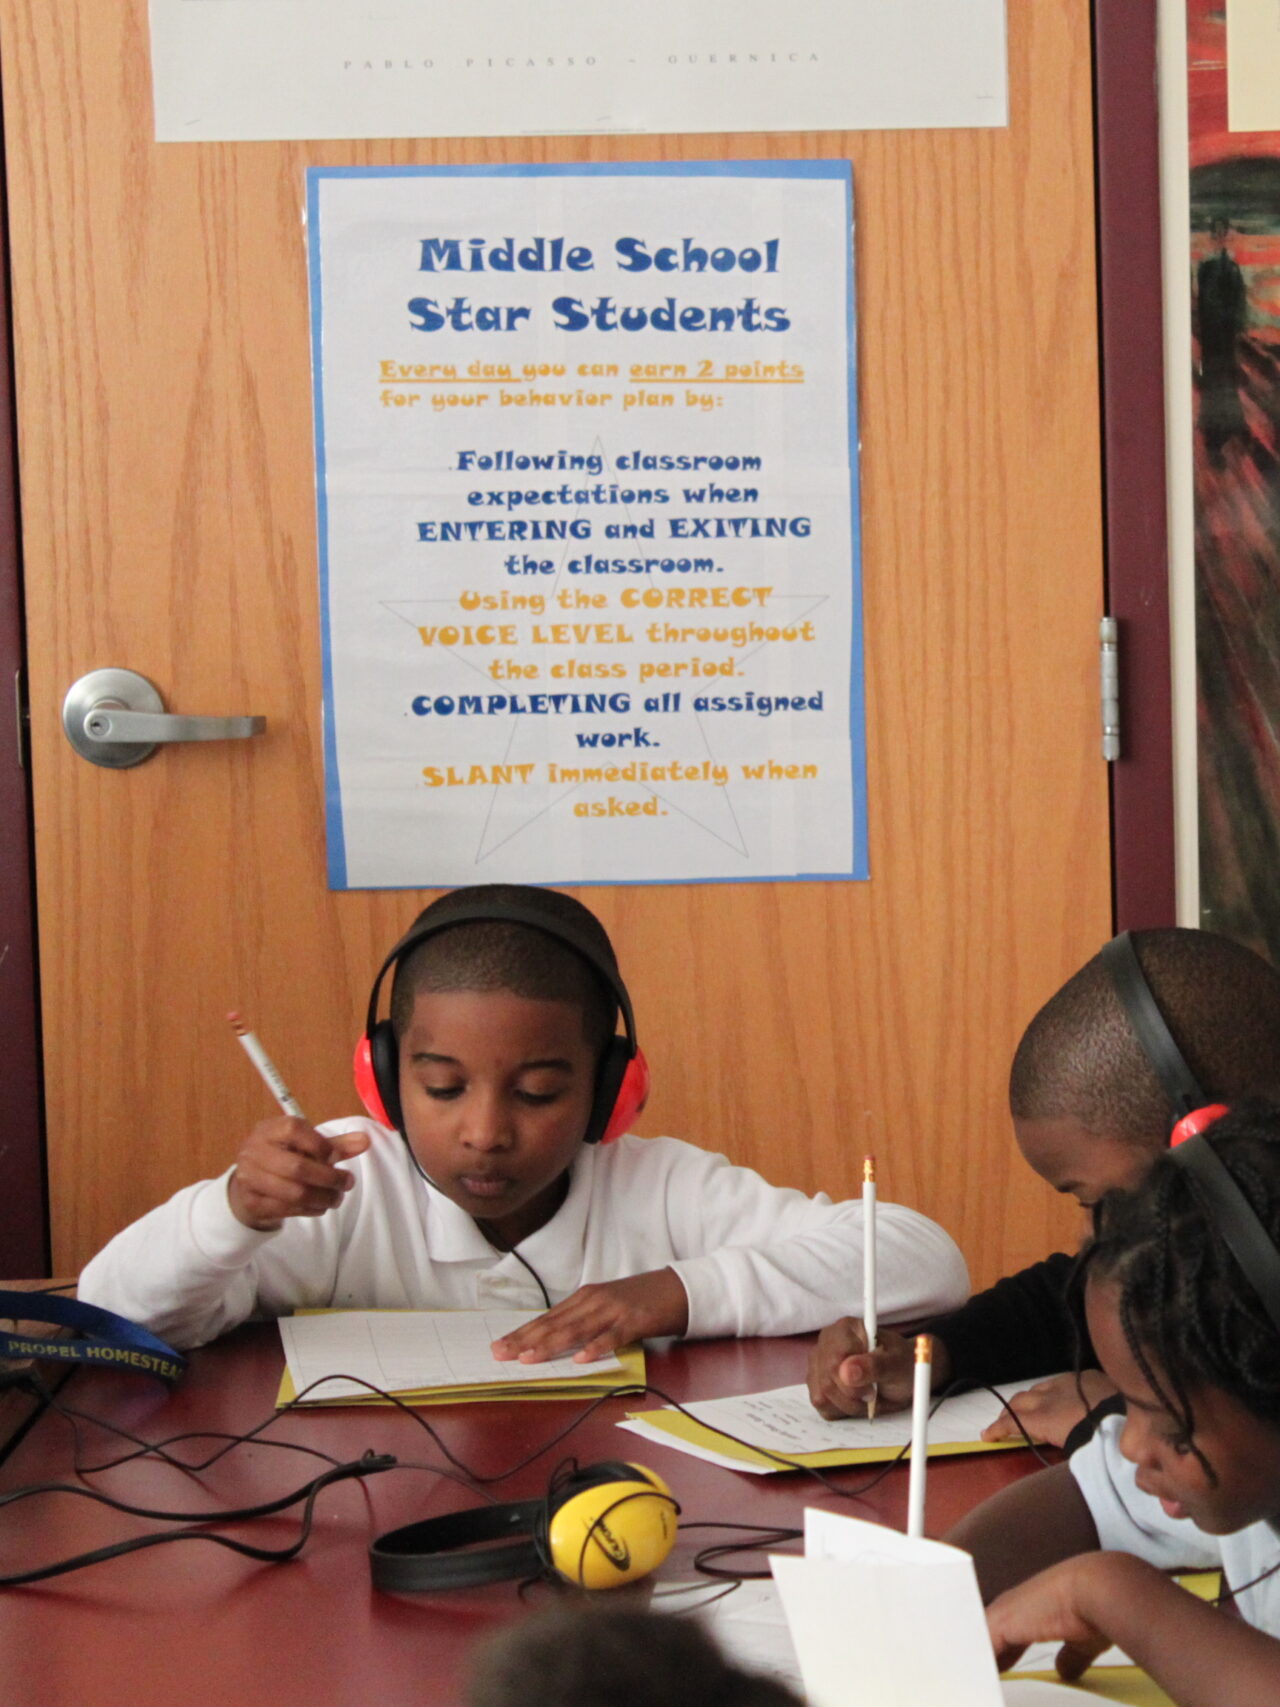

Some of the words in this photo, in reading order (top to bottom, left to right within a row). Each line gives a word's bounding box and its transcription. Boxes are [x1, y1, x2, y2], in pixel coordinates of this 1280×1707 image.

[343, 57, 436, 71] PABLO
[466, 55, 600, 69] PICASSO
[667, 51, 823, 66] GUERNICA
[417, 237, 594, 273] Middle
[614, 237, 780, 273] School
[407, 296, 532, 333] Star
[552, 297, 792, 333] Students
[379, 360, 457, 382] Every
[467, 360, 512, 382] day
[521, 363, 567, 383] you
[577, 363, 620, 378] can
[629, 362, 687, 378] earn
[696, 360, 714, 378] 2
[724, 360, 805, 382] points
[379, 389, 421, 408] for
[431, 393, 489, 412] your
[499, 389, 613, 408] behavior
[623, 389, 675, 411] plan
[685, 390, 724, 411] by:
[455, 450, 604, 475] Following
[615, 450, 762, 472] classroom
[467, 484, 670, 510] expectations
[683, 483, 760, 503] when
[416, 519, 593, 542] ENTERING
[605, 519, 655, 539] and
[668, 517, 813, 538] EXITING
[504, 556, 555, 575] the
[567, 554, 725, 575] classroom.
[458, 589, 547, 614] Using
[556, 588, 609, 609] the
[620, 586, 774, 609] CORRECT
[418, 624, 519, 647] VOICE
[531, 623, 634, 645] LEVEL
[645, 621, 817, 648] throughout
[488, 659, 540, 681] the
[550, 658, 629, 680] class
[639, 656, 746, 684] period.
[410, 692, 632, 716] COMPLETING
[644, 692, 681, 714] all
[693, 691, 825, 716] assigned
[576, 727, 661, 749] work.
[421, 763, 536, 788] SLANT
[547, 760, 731, 787] immediately
[740, 759, 820, 781] when
[573, 795, 669, 818] asked.
[8, 1340, 81, 1358] PROPEL
[86, 1347, 184, 1378] HOMESTEA
